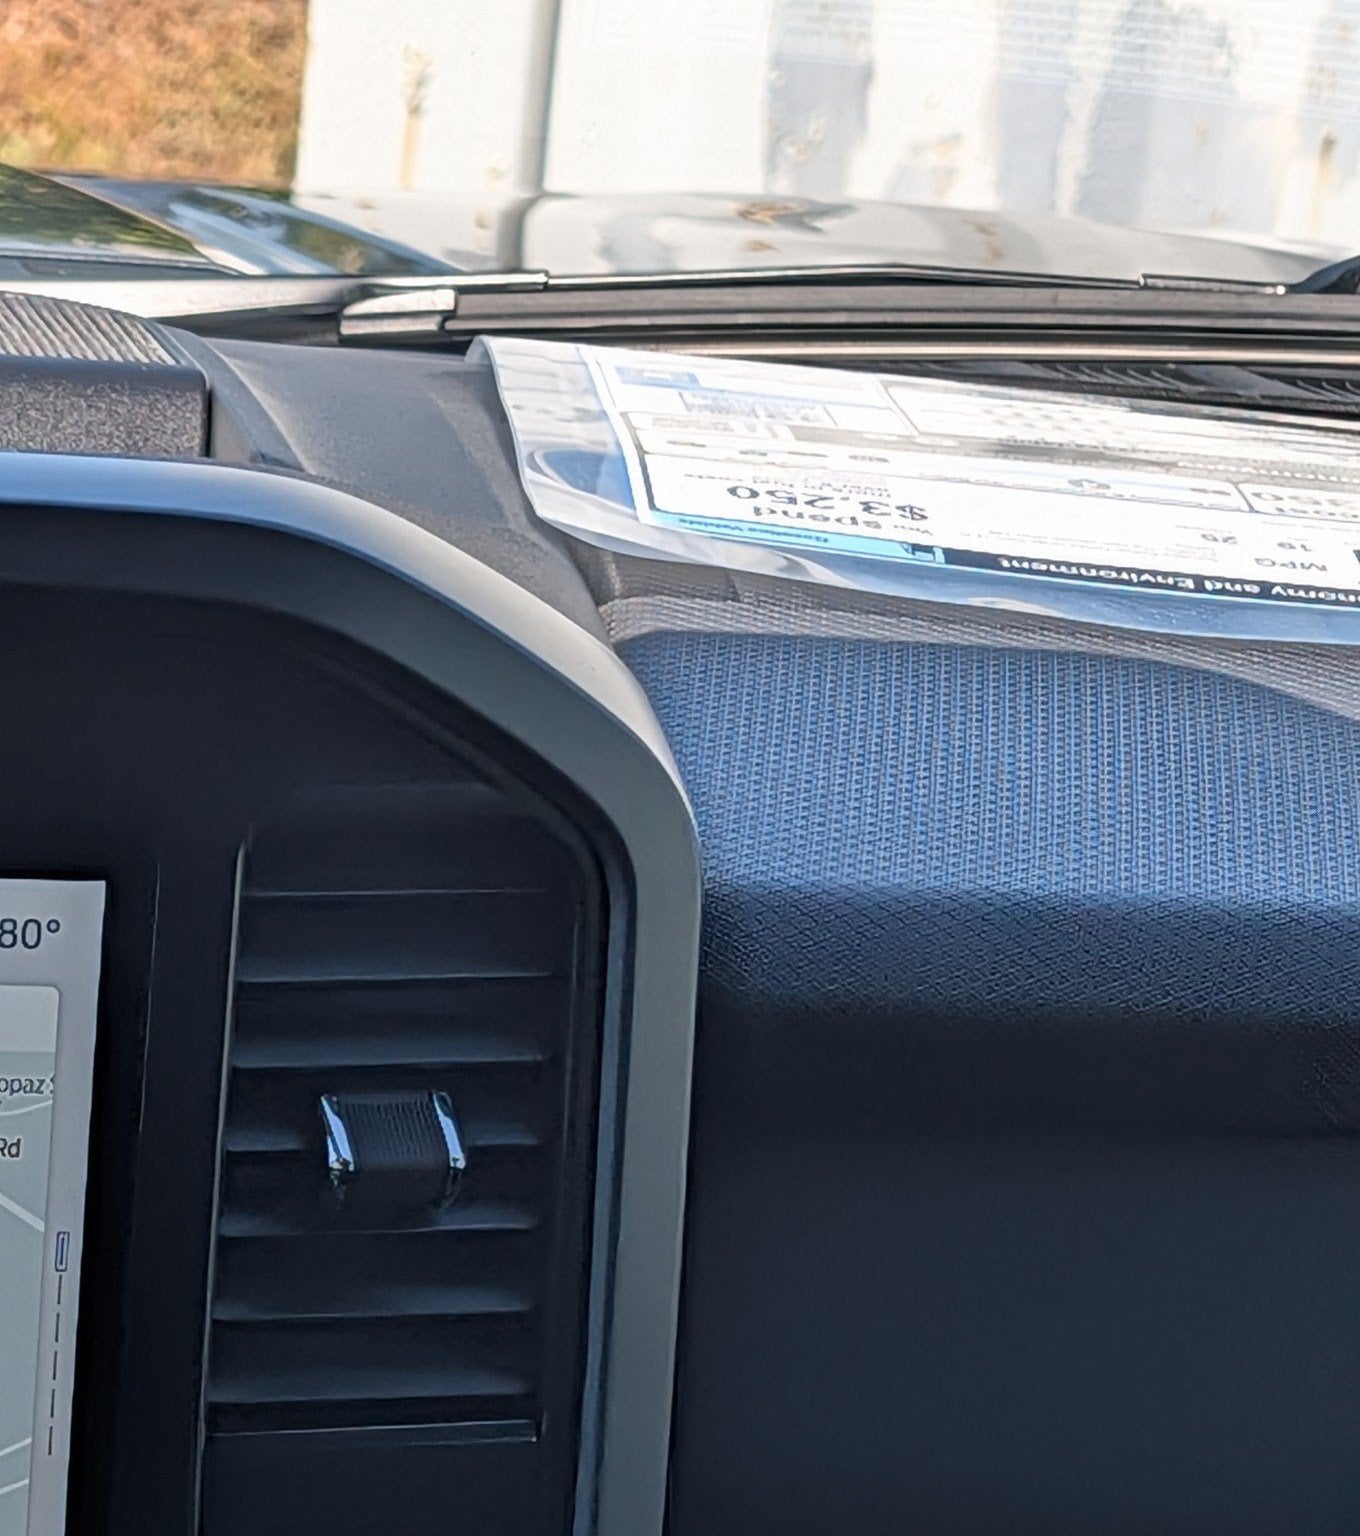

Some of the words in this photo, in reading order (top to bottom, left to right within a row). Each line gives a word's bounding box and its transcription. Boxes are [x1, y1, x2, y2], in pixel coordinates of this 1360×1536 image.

[727, 484, 929, 521] $3,250
[752, 505, 882, 530] spend
[997, 556, 1195, 589] Environment
[1203, 578, 1262, 595] and
[1271, 585, 1360, 604] nomy
